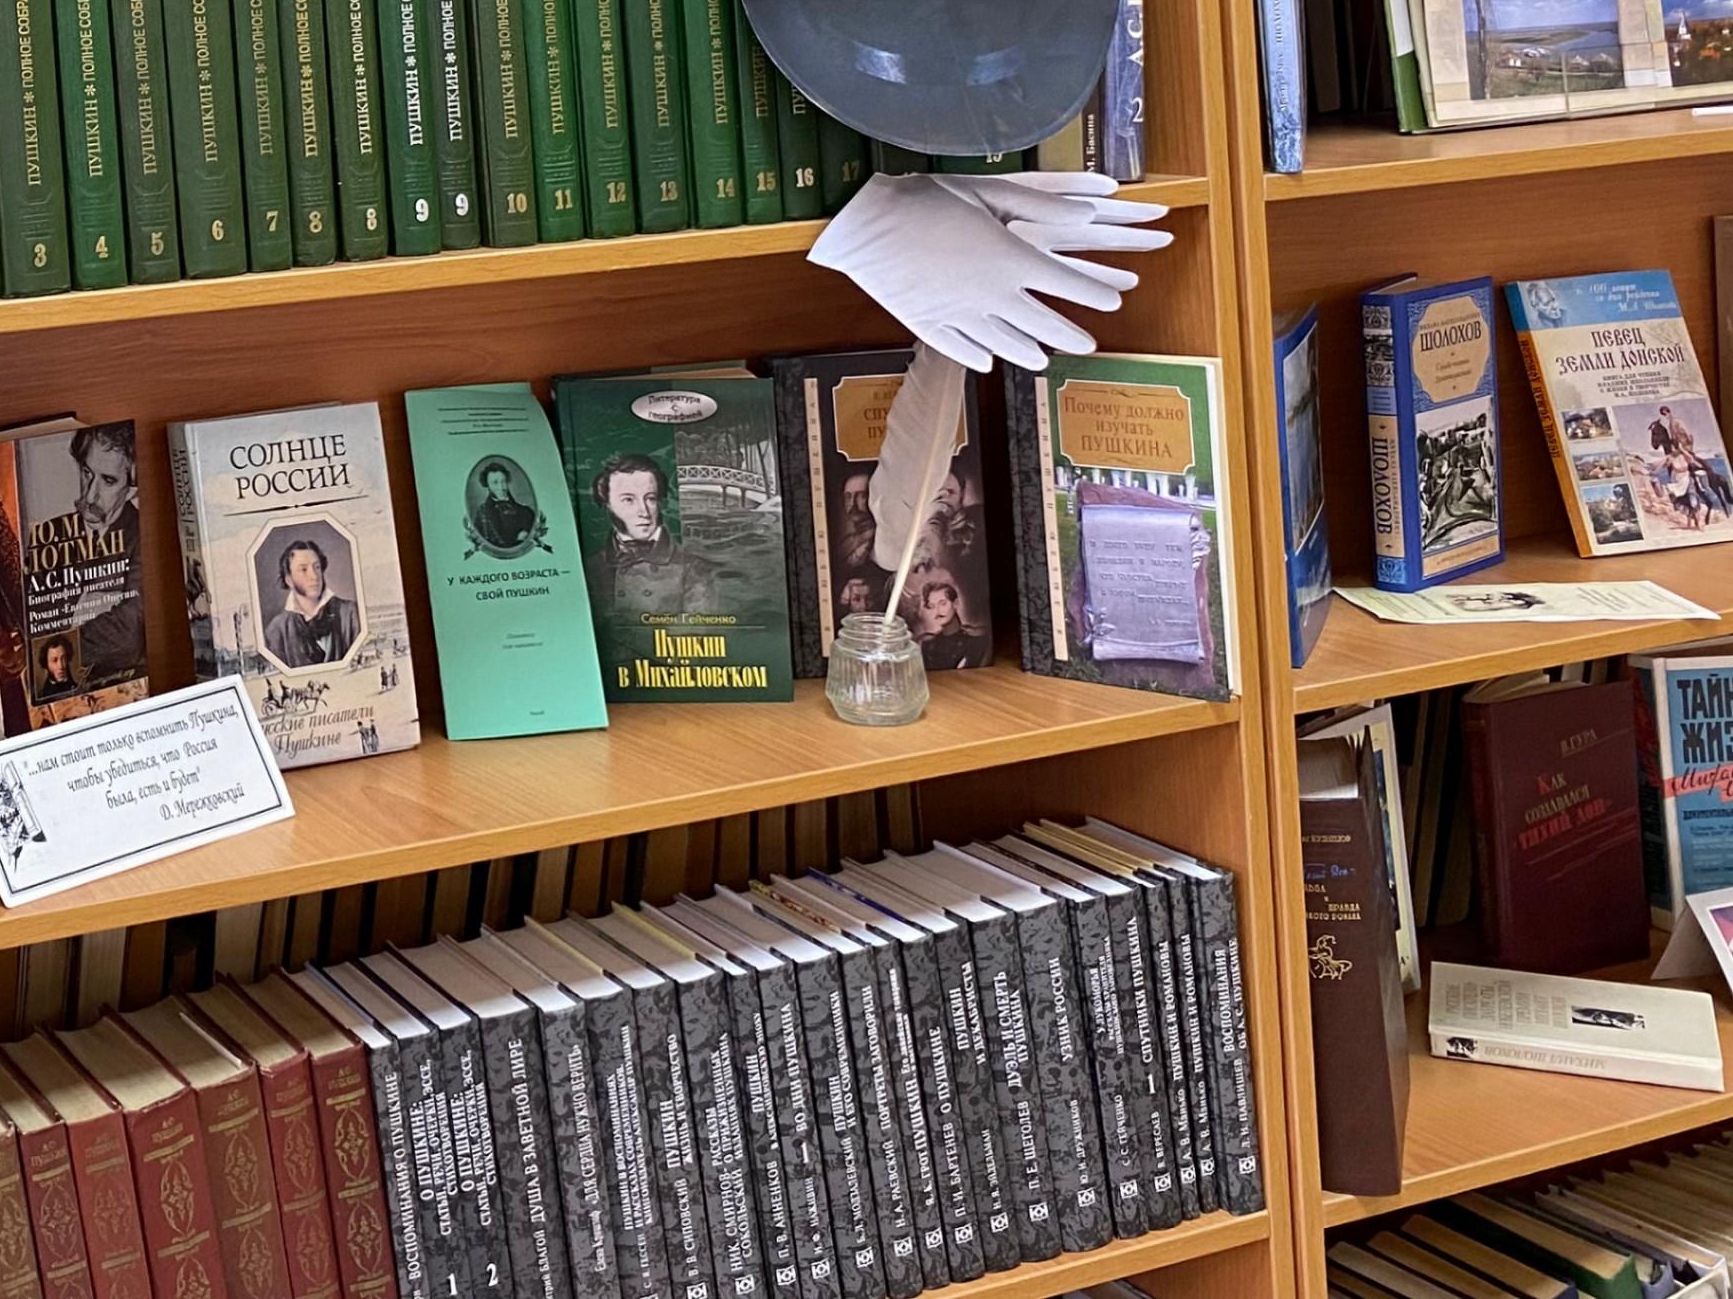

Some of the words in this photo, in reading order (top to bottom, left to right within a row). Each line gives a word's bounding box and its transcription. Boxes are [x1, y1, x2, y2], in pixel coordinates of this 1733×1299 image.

[401, 3, 415, 52] ПОЛНОЕ
[405, 67, 423, 146] ПУШКИН
[717, 178, 735, 198] 14
[796, 167, 814, 188] 16
[415, 199, 428, 221] 9
[507, 193, 527, 213] 10
[211, 219, 224, 240] 6
[95, 235, 109, 258] 4
[1420, 321, 1482, 353] ШОЛОХОВ
[1591, 328, 1645, 349] ПЕВЕЦ
[1556, 350, 1615, 376] ЗЕМЛИ
[1620, 343, 1685, 370] ДОНСКОЙ
[1065, 396, 1121, 419] Почему
[1126, 405, 1184, 421] должно
[1096, 420, 1153, 436] изучать
[229, 434, 347, 471] СОЛНЦЕ
[1081, 435, 1172, 458] ПУШКИНА
[236, 463, 351, 500] РОССИИ
[1372, 436, 1393, 534] ШОЛОХОВ
[25, 529, 125, 574] ЛОТМАН
[459, 571, 509, 586] КАЖДОГО
[512, 569, 560, 582] ВОЗРАСТА
[476, 587, 503, 601] СВОЙ
[505, 586, 550, 599] ПУШКИН
[29, 608, 59, 622] Роман
[682, 613, 736, 624] Гейченко
[654, 629, 726, 661] Пушкин
[618, 667, 629, 688] в
[635, 658, 767, 688] Михайловском
[309, 705, 374, 728] писатели
[61, 746, 95, 766] стоит
[97, 735, 134, 756] только
[274, 729, 341, 759] Пушкине
[67, 766, 104, 792] чтобы
[161, 750, 180, 766] что
[183, 738, 218, 757] Россия
[138, 783, 162, 799] есть
[1127, 916, 1144, 987] ПУШКИНА
[1049, 957, 1067, 1016] РОССИИ
[1159, 941, 1174, 1011] РОМАНОВЫ
[949, 987, 969, 1051] ПУШКИН
[1135, 990, 1152, 1063] СПУТНИКИ
[1055, 1018, 1073, 1062] УЗНИК
[1168, 1025, 1184, 1081] ПУШКИН
[508, 1038, 527, 1080] ЛИРЕ
[929, 1026, 951, 1100] ПУШКИНЕ
[385, 1072, 405, 1146] ПУШКИНЕ
[873, 1064, 891, 1130] ПОРТРЕТЫ
[941, 1103, 952, 1113] О
[511, 1081, 537, 1162] ЗАВЕТНОЙ
[660, 1099, 681, 1169] ПУШКИН
[395, 1148, 406, 1159] О
[525, 1163, 538, 1175] В
[527, 1177, 546, 1223] ДУША
[395, 1161, 421, 1280] ВОСПОМИНАНИЯ
[447, 1273, 458, 1295] 1
[486, 1263, 499, 1287] 2
